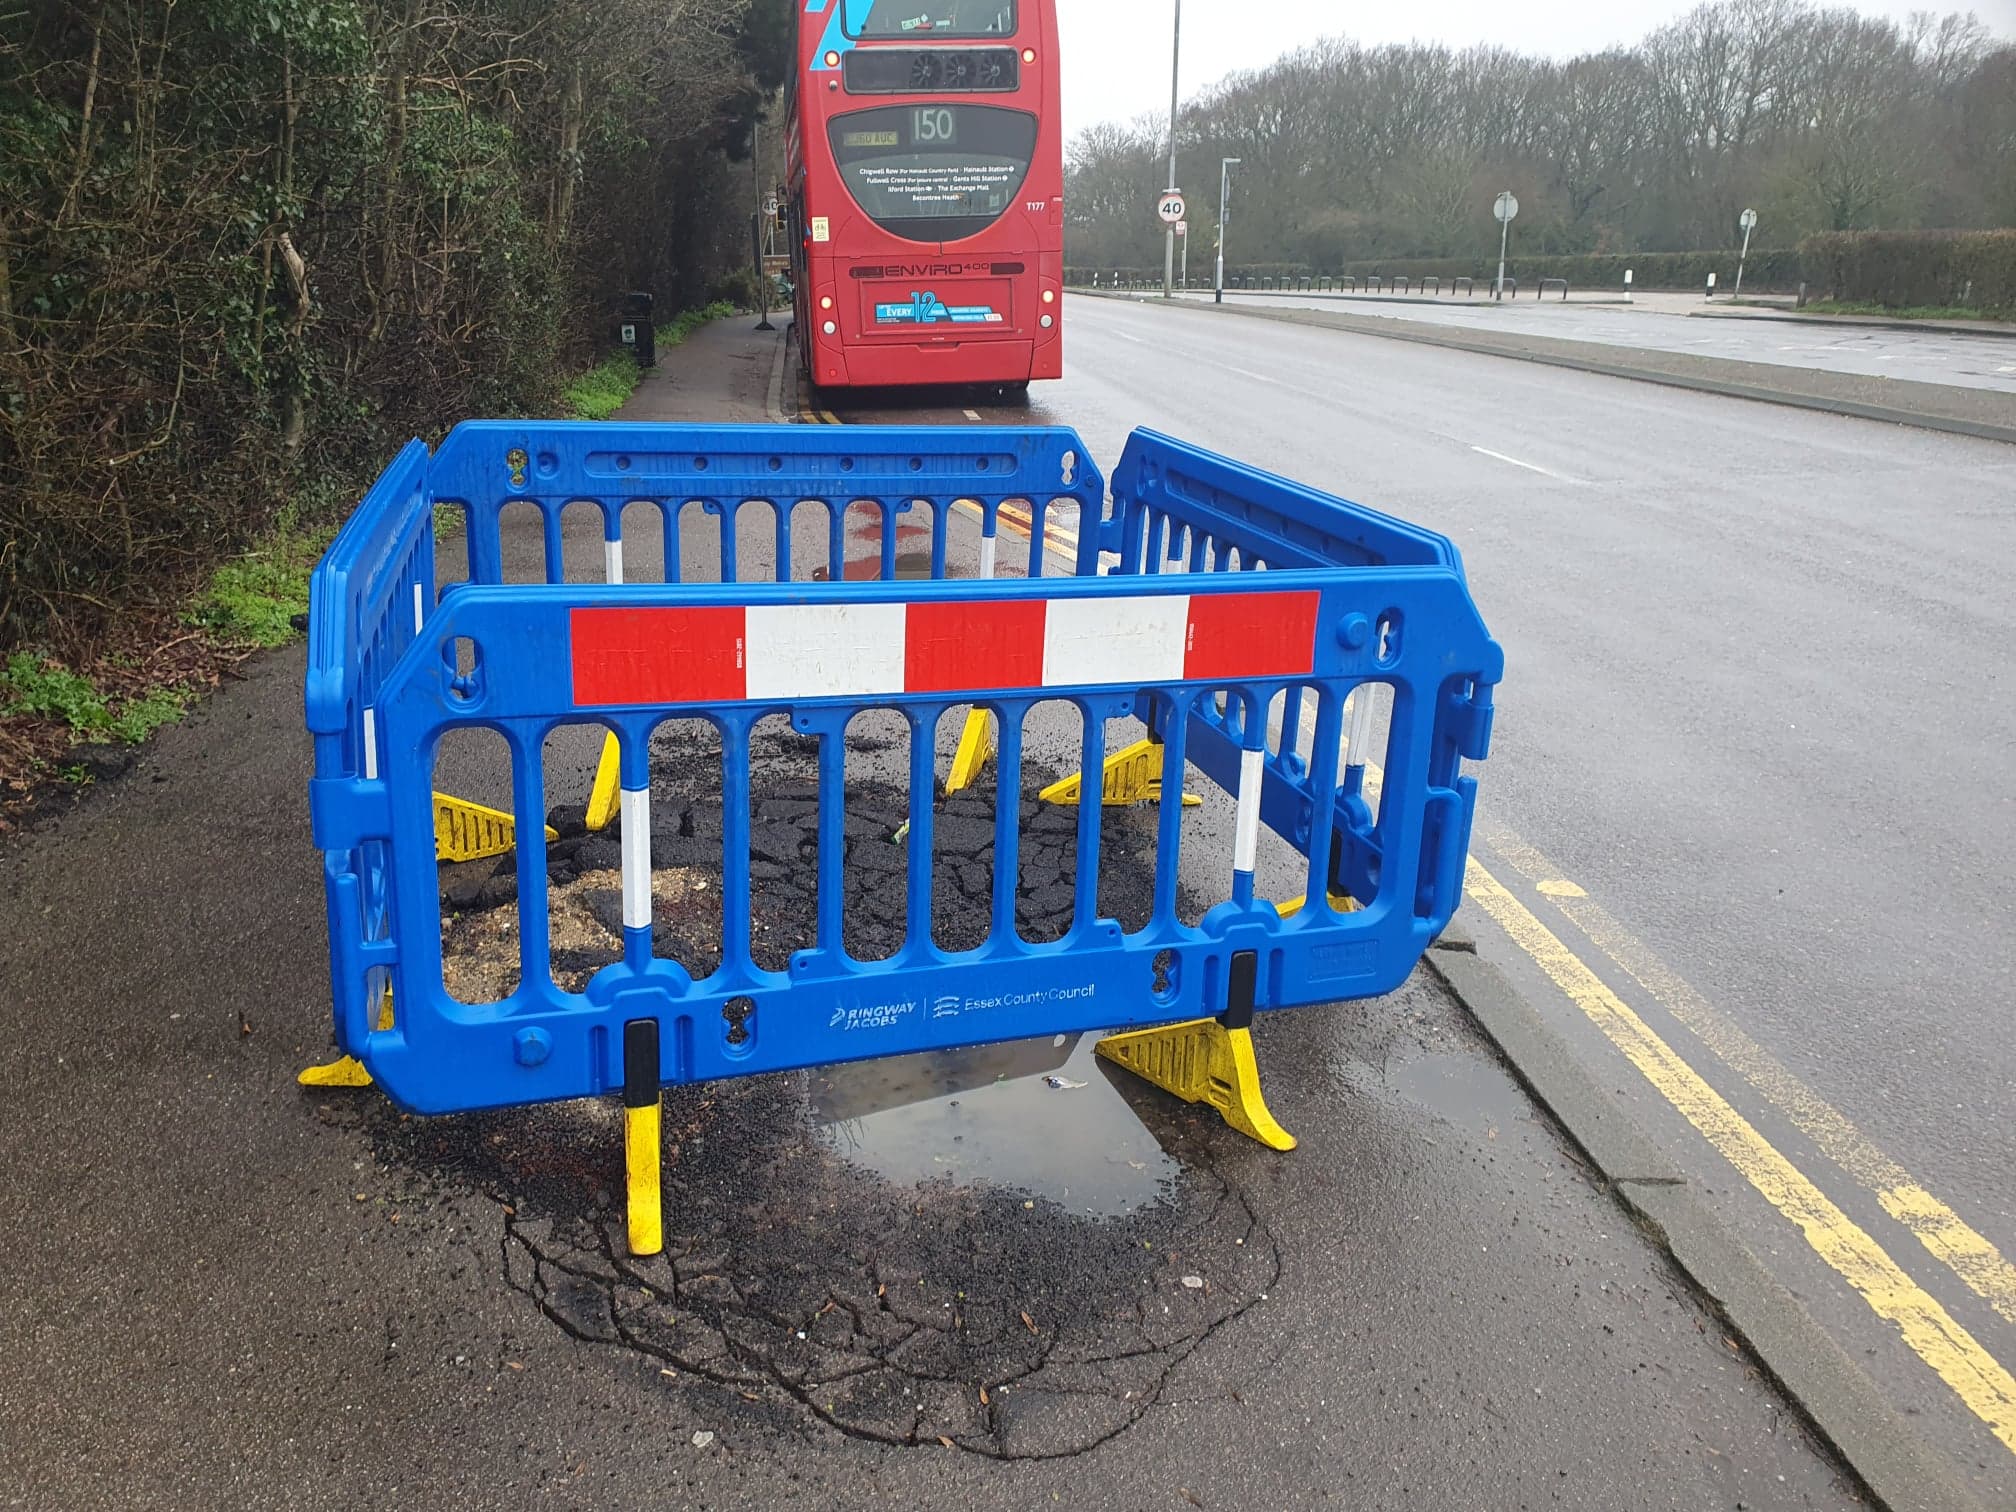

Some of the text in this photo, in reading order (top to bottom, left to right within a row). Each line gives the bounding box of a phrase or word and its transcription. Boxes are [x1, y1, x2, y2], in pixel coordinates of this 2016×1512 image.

[914, 109, 953, 140] 150
[1026, 201, 1045, 211] T177
[1162, 202, 1182, 214] 40
[886, 290, 937, 323] EVERY 12
[964, 983, 1095, 1011] Essex County Council
[847, 1001, 917, 1020] RINGWAY
[844, 1015, 898, 1031] JACOBS
